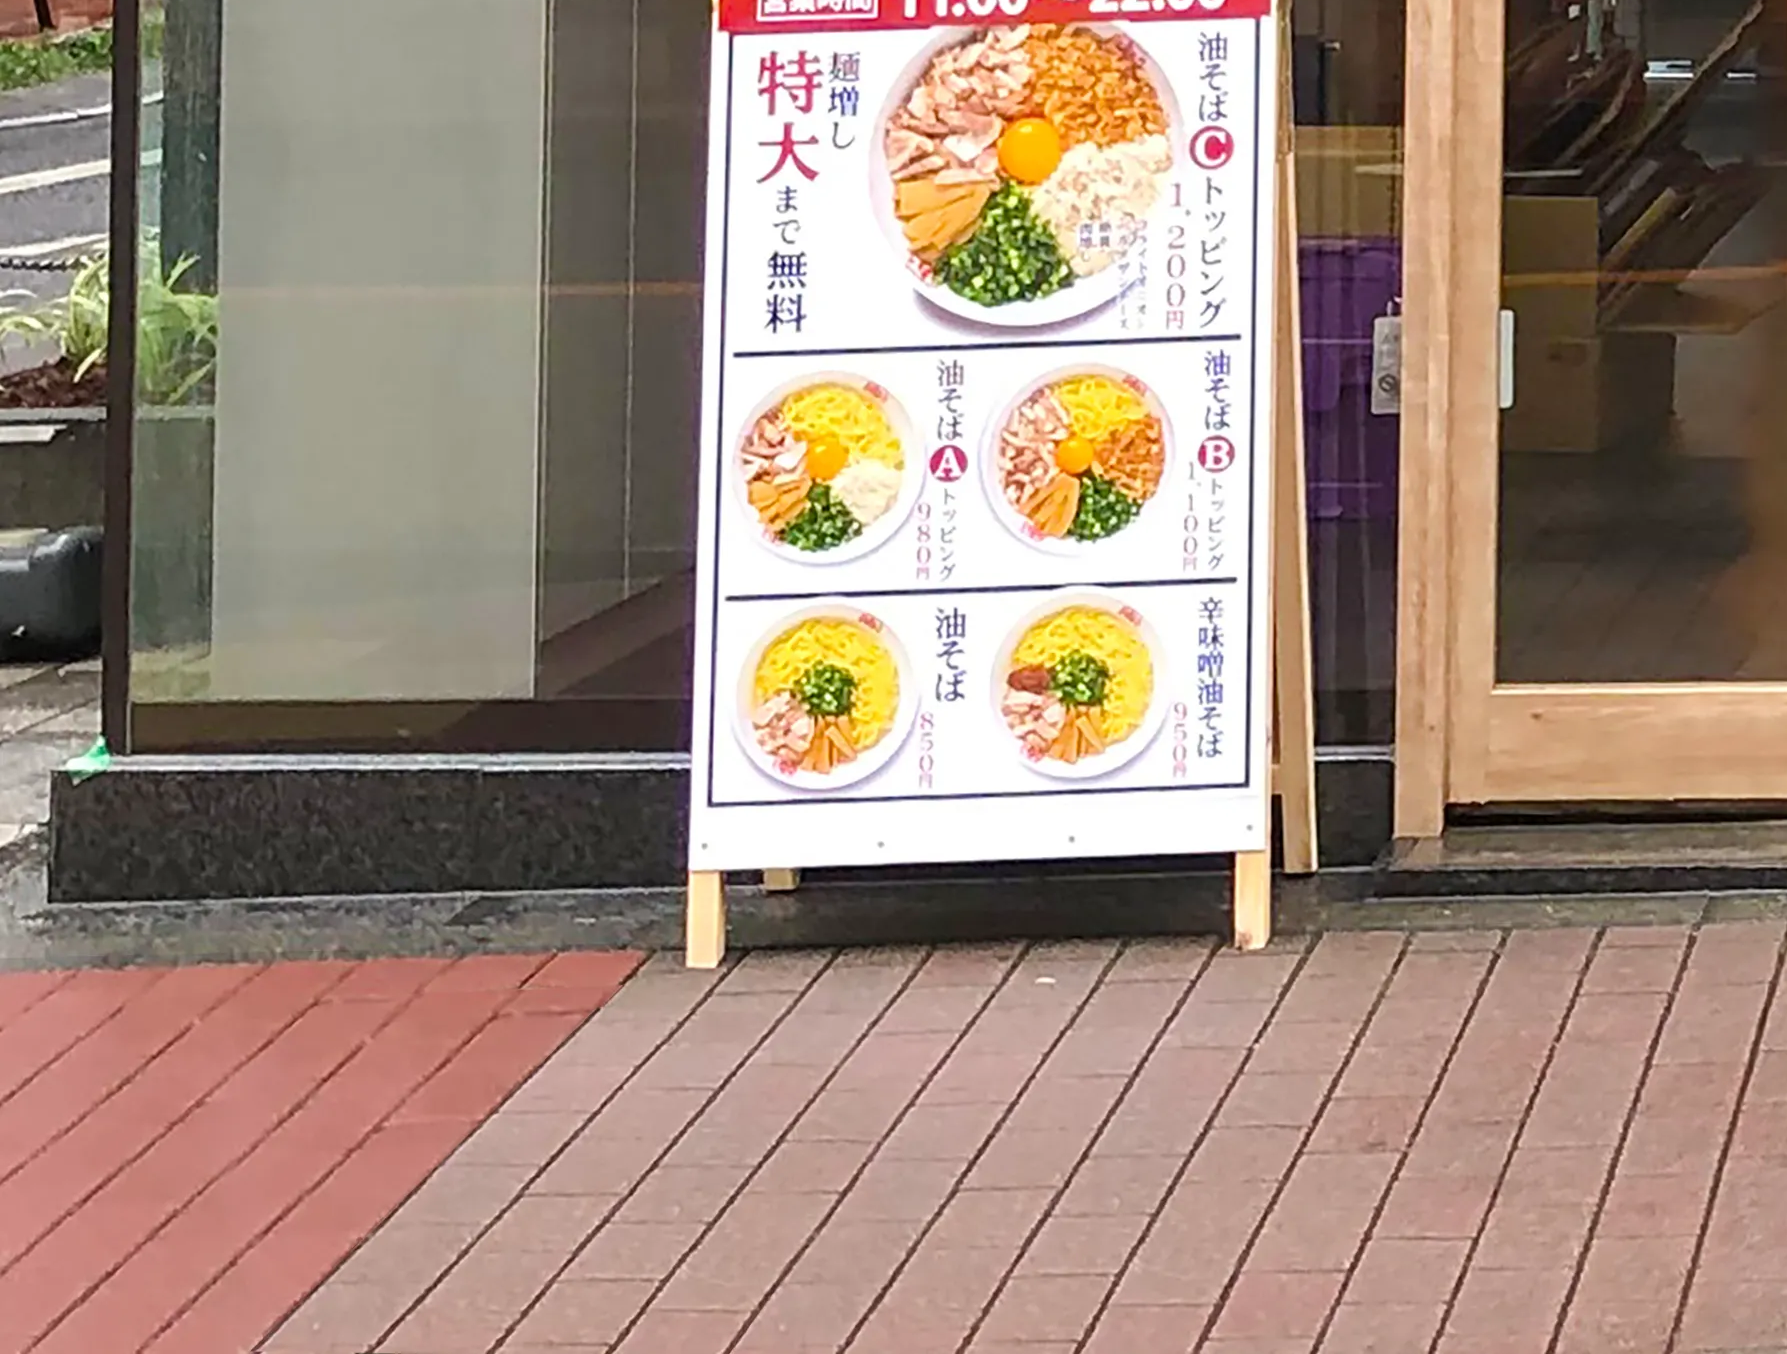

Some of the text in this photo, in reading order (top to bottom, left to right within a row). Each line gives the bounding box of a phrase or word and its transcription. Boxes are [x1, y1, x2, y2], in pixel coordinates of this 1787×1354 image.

[828, 51, 861, 151] 麺増し
[756, 49, 824, 334] 特大まで無料
[935, 606, 969, 703] 油そば
